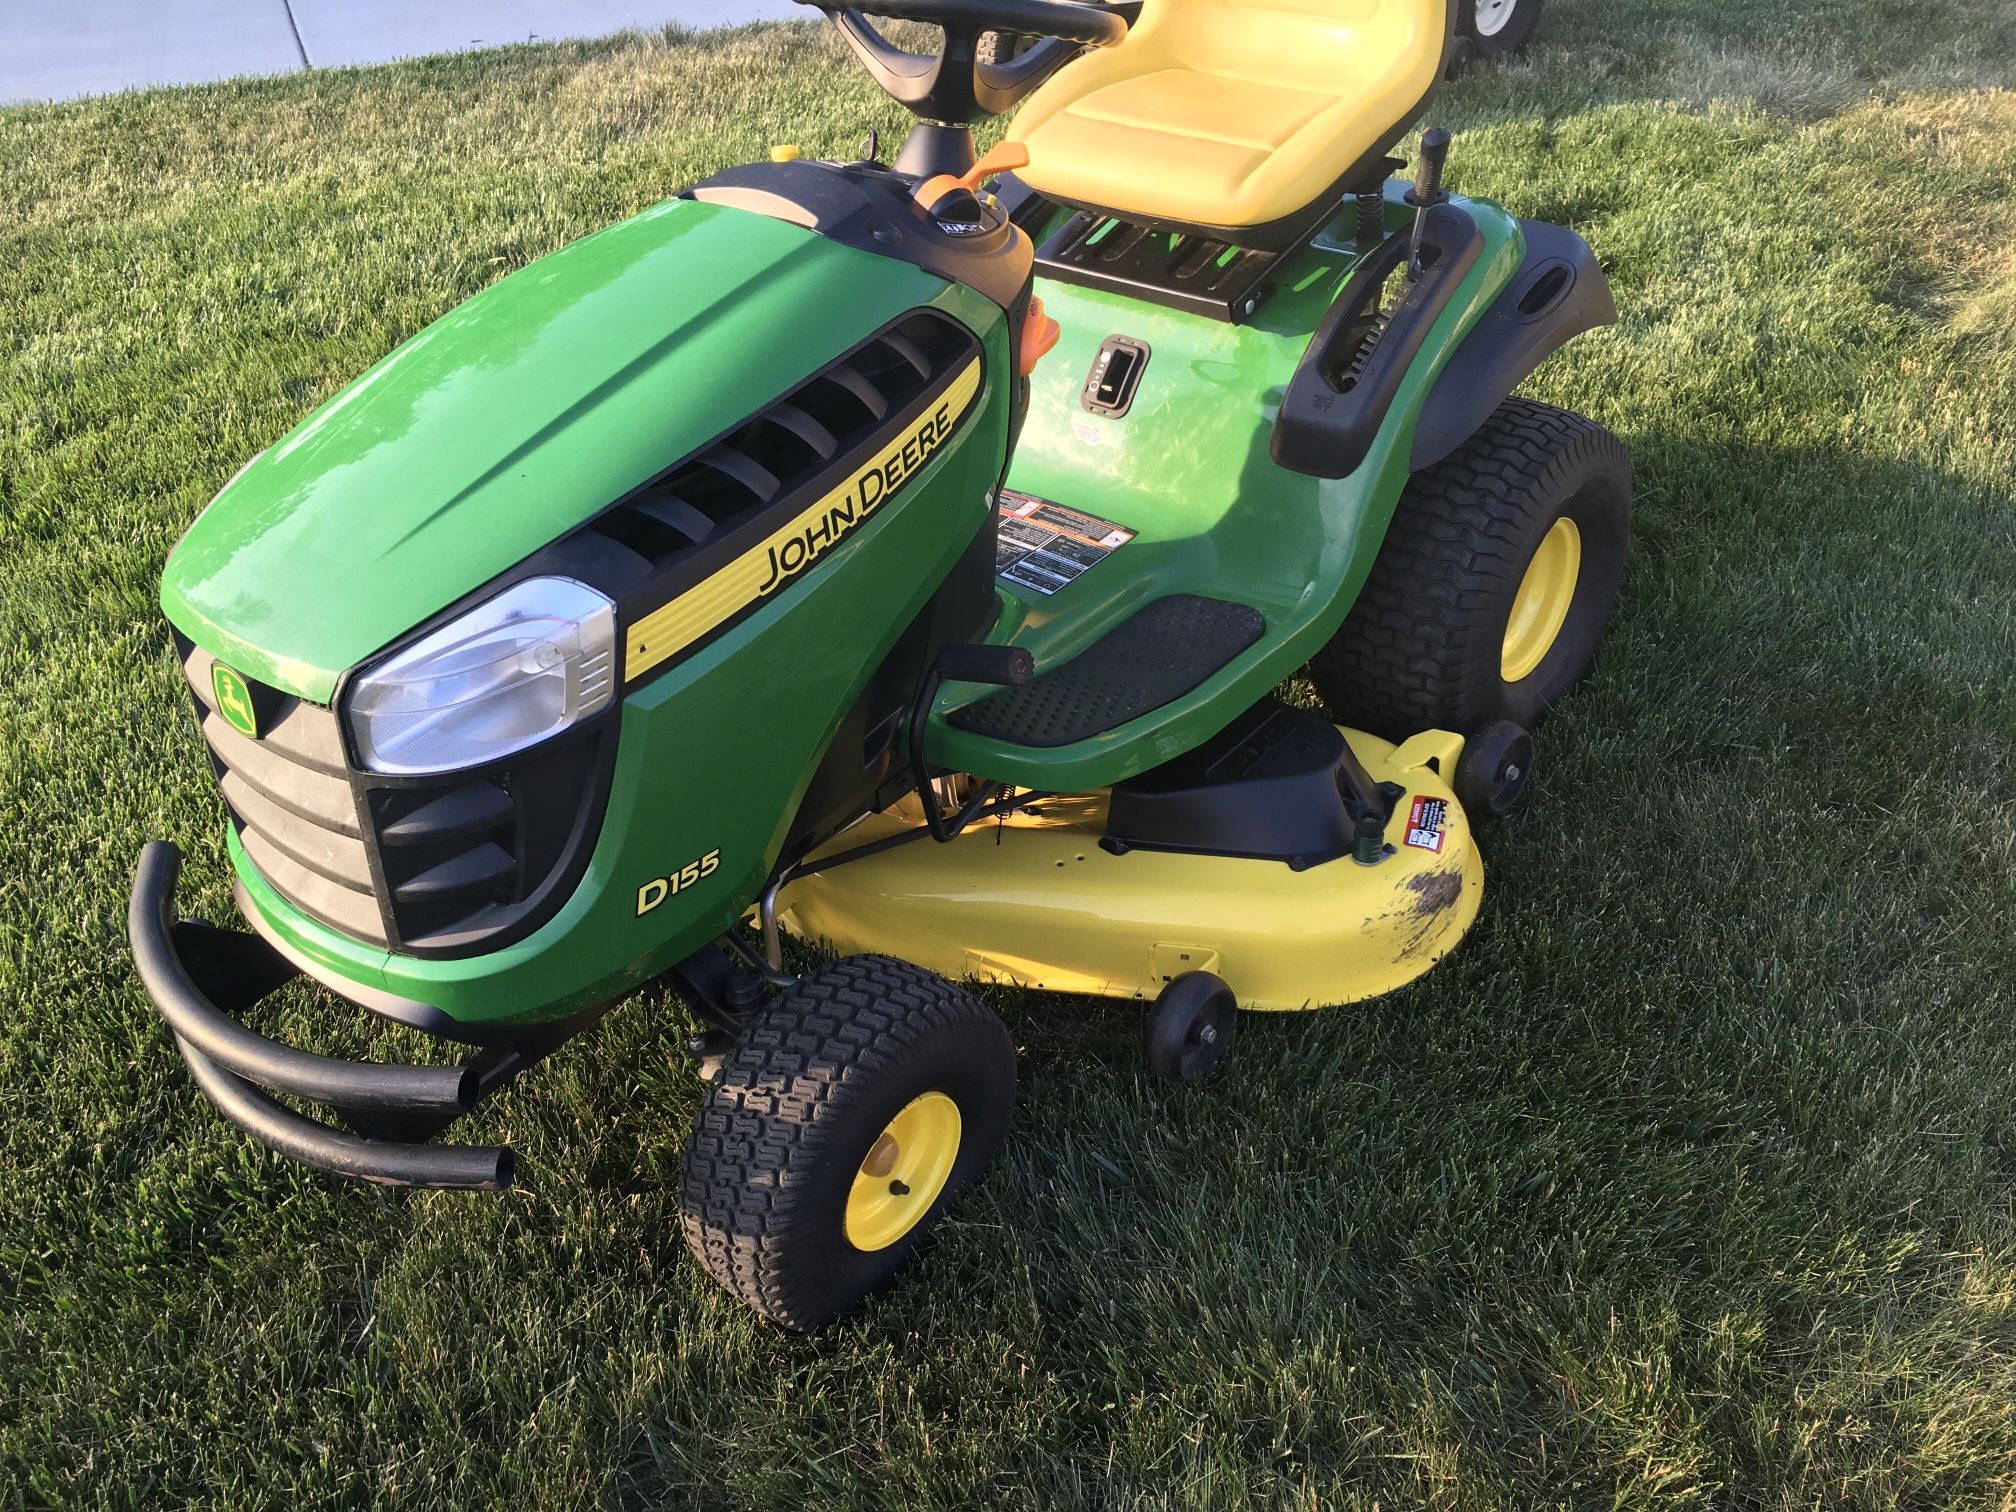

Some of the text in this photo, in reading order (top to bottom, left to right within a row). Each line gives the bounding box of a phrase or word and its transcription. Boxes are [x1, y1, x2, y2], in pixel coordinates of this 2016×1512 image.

[759, 401, 951, 593] JOHN DEERE
[636, 847, 720, 917] D155
